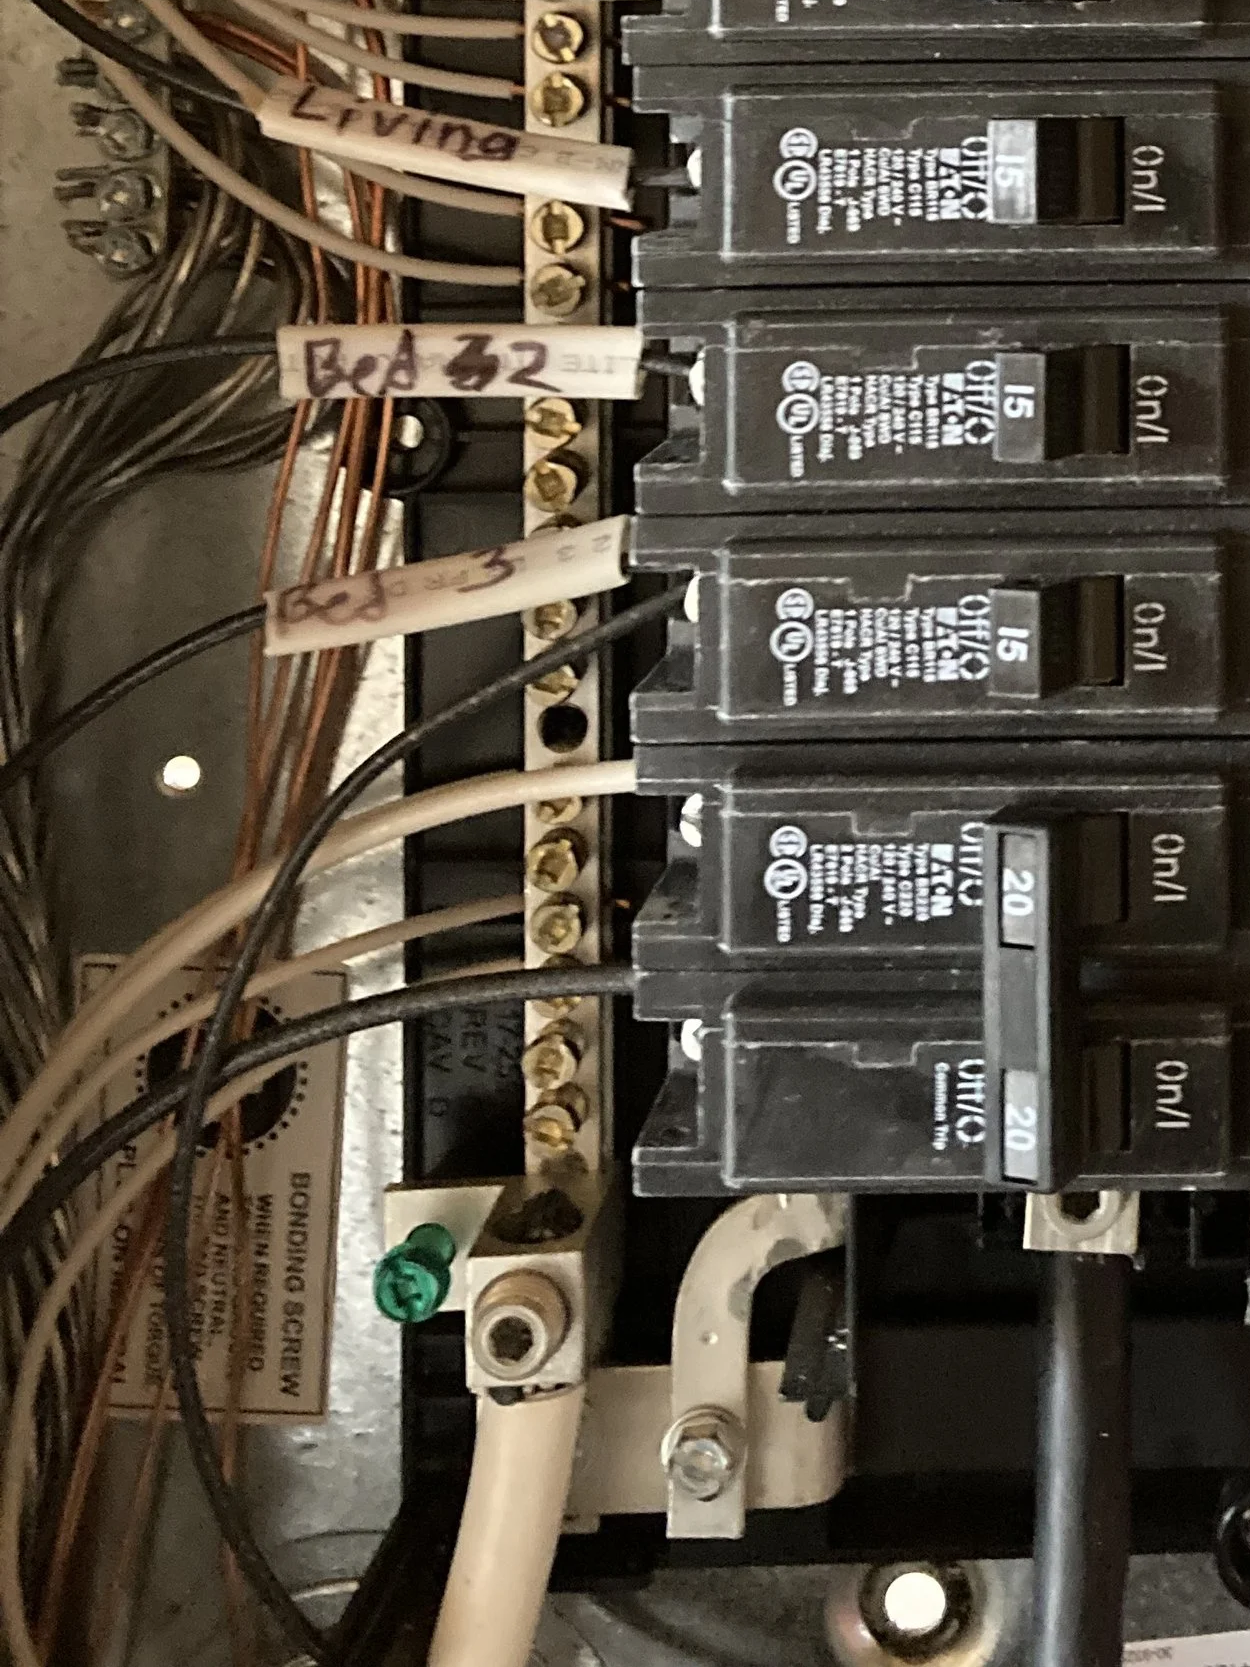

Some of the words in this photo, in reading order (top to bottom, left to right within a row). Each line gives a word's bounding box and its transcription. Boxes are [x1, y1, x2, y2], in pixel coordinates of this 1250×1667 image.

[995, 154, 1027, 187] 15
[305, 329, 418, 397] Bed
[1003, 384, 1035, 419] 15
[278, 573, 386, 622] Bed
[997, 626, 1030, 662] 15
[1002, 867, 1036, 917] 20
[1004, 1103, 1037, 1152] 20
[283, 1172, 312, 1293] BONDING
[279, 1300, 306, 1399] SCREW
